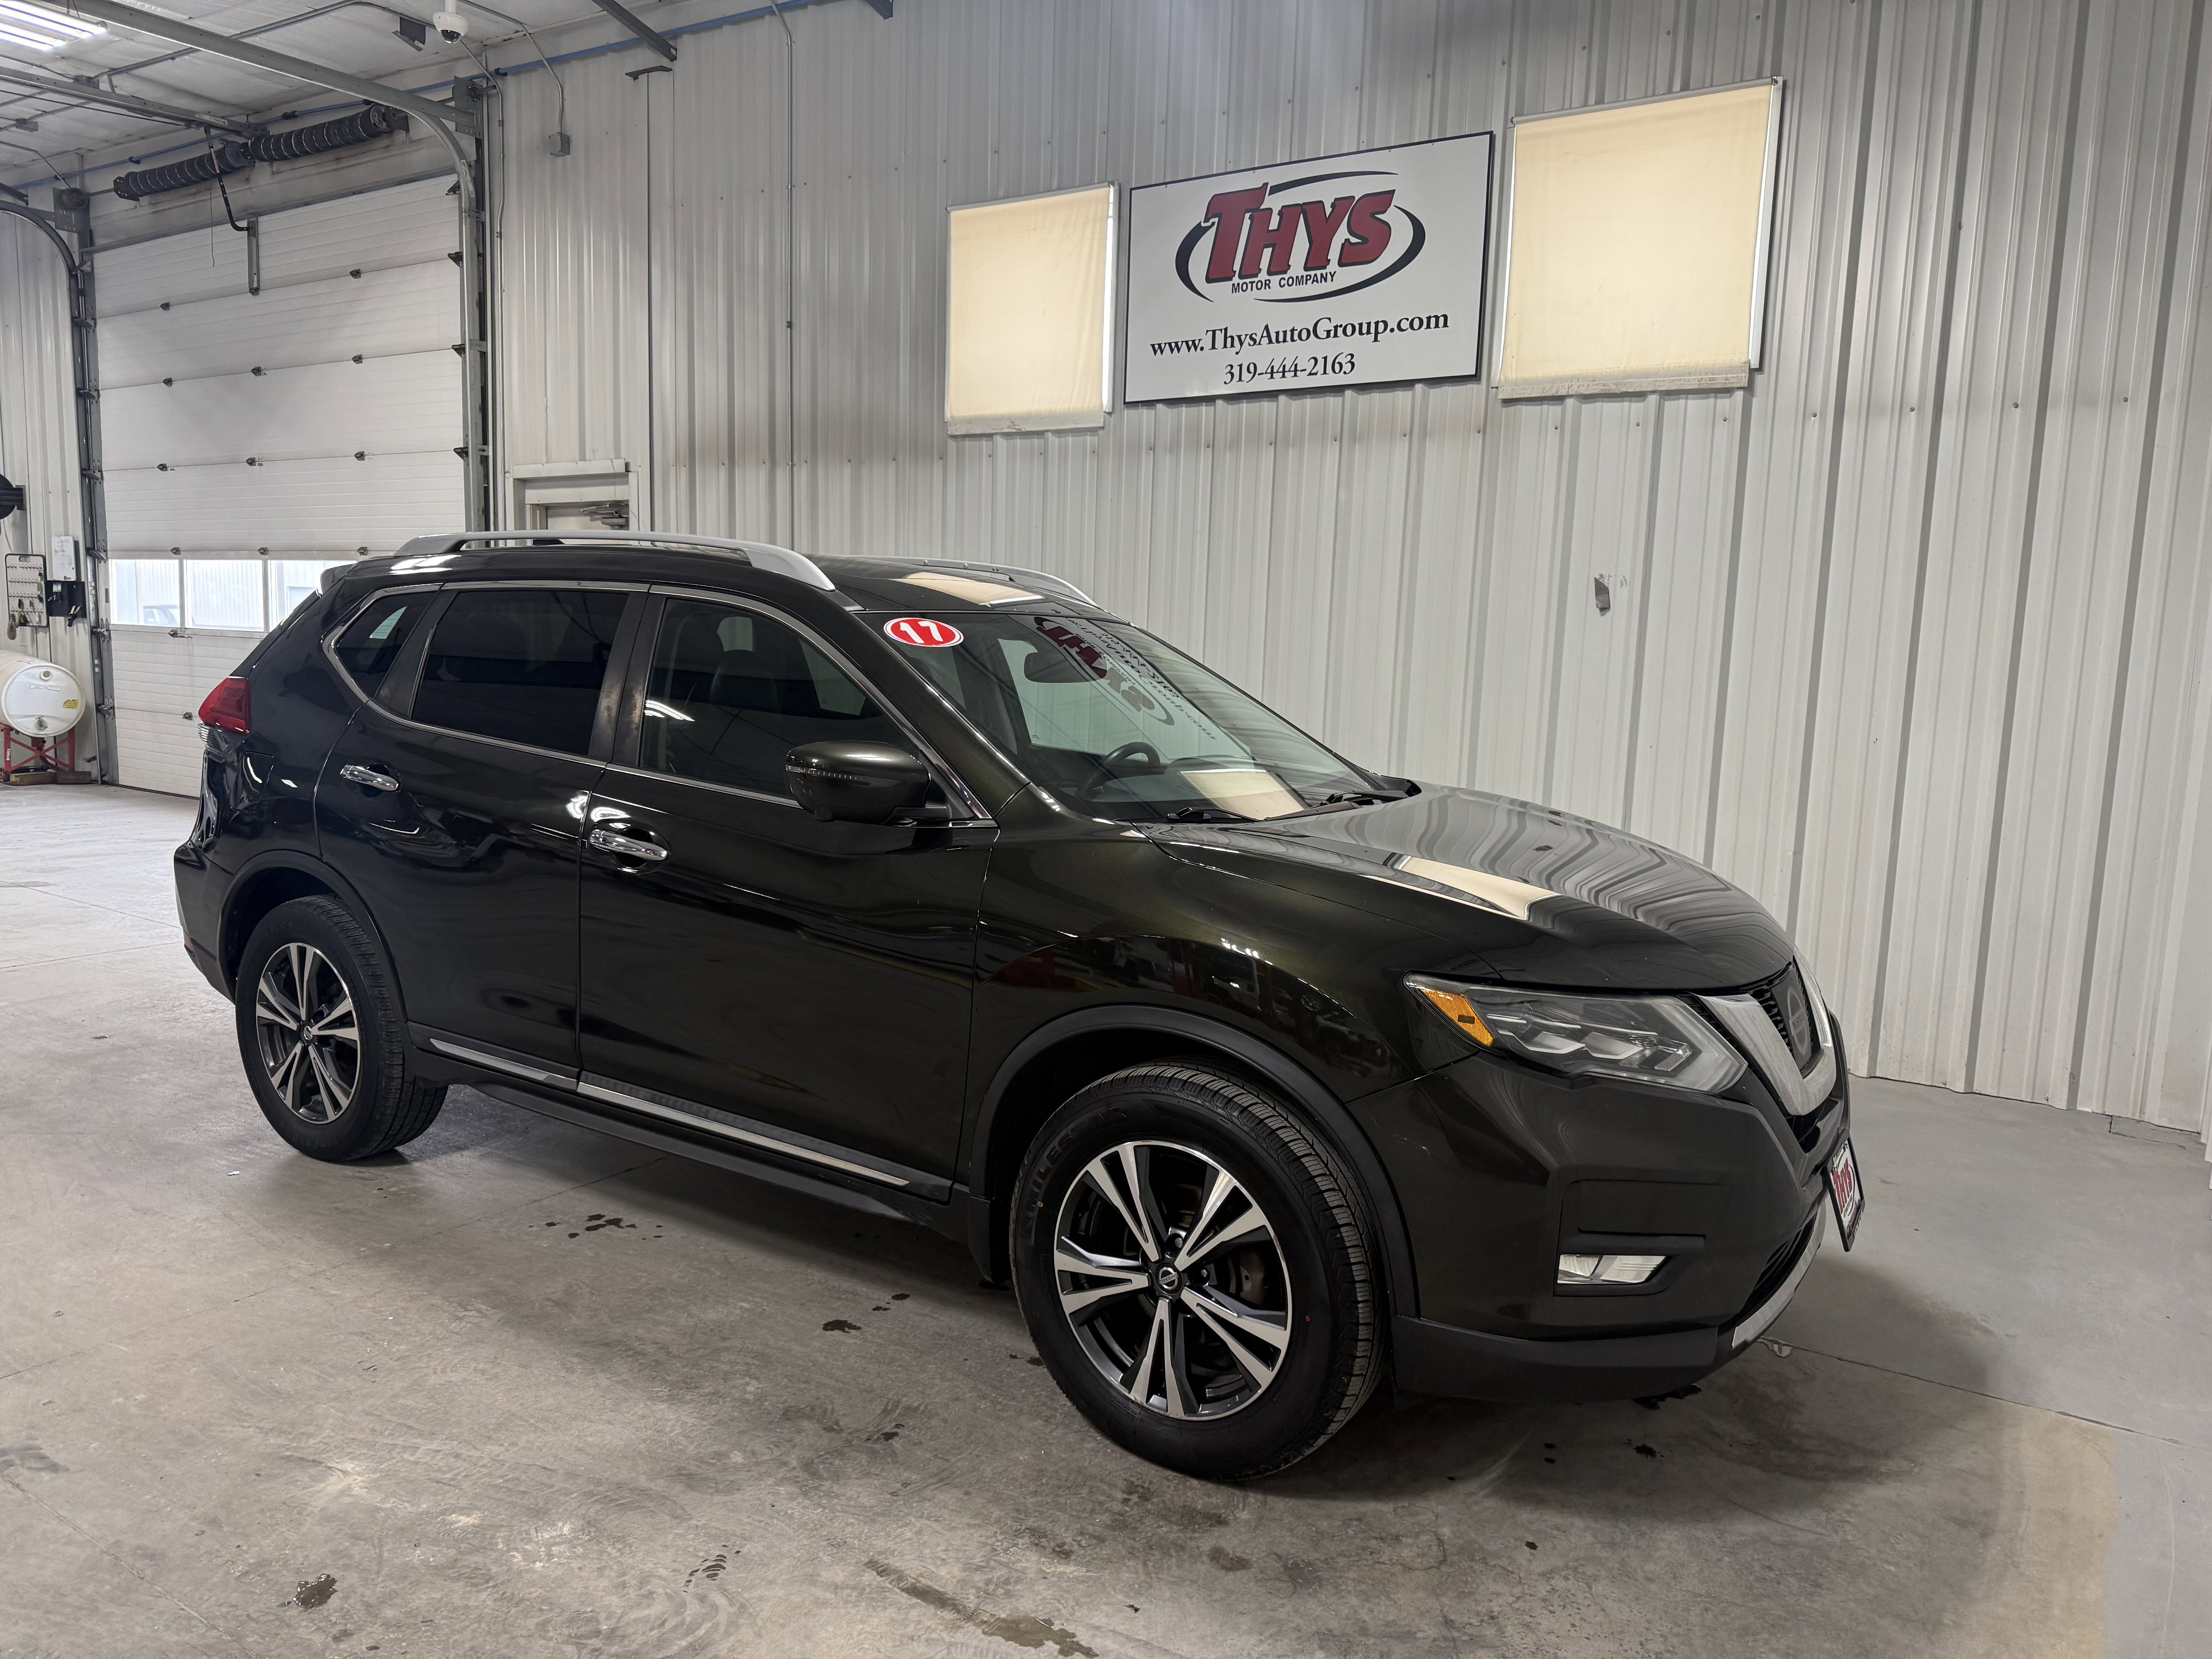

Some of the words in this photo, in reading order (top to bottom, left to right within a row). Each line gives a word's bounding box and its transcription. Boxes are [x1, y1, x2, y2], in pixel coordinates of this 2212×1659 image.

[1231, 279, 1271, 294] MOTOR
[1279, 271, 1337, 288] COMPANY
[1149, 313, 1449, 356] www.ThysAutoGroup.com
[1223, 352, 1355, 385] 319-444-2163
[899, 620, 944, 644] 17
